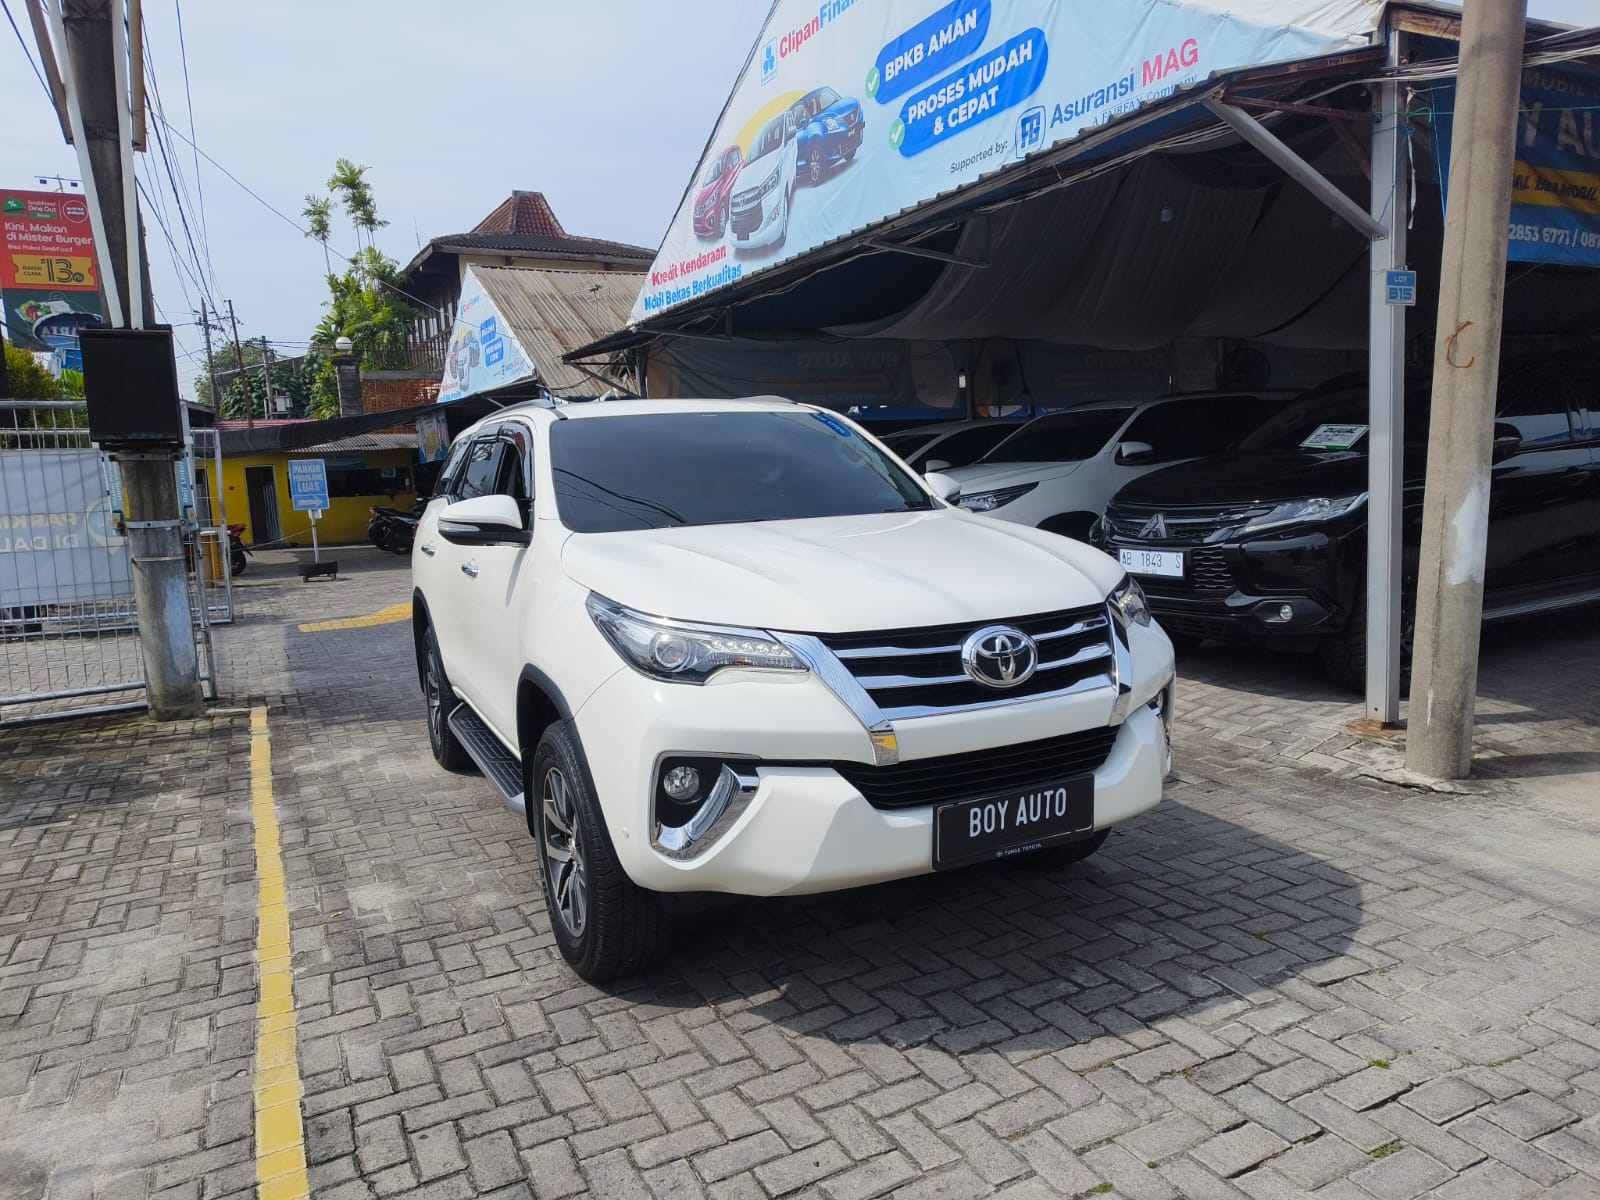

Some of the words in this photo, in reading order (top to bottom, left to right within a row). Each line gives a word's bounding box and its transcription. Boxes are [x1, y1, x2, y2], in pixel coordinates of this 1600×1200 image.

[780, 0, 858, 58] ClipanFina
[885, 43, 924, 82] BPKB
[927, 8, 977, 57] AMAN
[908, 81, 965, 124] PROSES
[968, 39, 1033, 92] MUDAH
[1050, 67, 1134, 129] Asuransi
[1142, 38, 1199, 87] MAG
[933, 114, 945, 136] &
[947, 85, 999, 128] CEPAT
[950, 145, 993, 173] Supported
[995, 140, 1008, 155] by:
[44, 205, 57, 213] Out
[4, 221, 28, 232] Kini,
[30, 223, 68, 234] Makan
[6, 231, 16, 240] di
[18, 232, 53, 243] Mister
[56, 235, 92, 246] Burger
[1508, 223, 1540, 241] 2853
[651, 262, 679, 287] Kredit
[680, 245, 727, 278] Kendaraan
[666, 284, 691, 305] Bekas
[692, 263, 743, 297] Berkualitas
[1394, 275, 1407, 283] LOT
[1389, 287, 1412, 300] B15
[293, 463, 321, 473] PARKIR
[297, 481, 321, 492] LUAS
[1122, 551, 1132, 566] AB
[1141, 552, 1162, 568] 1843
[1175, 554, 1182, 569] S
[968, 800, 1009, 838] BOY
[1015, 787, 1068, 827] AUTO
